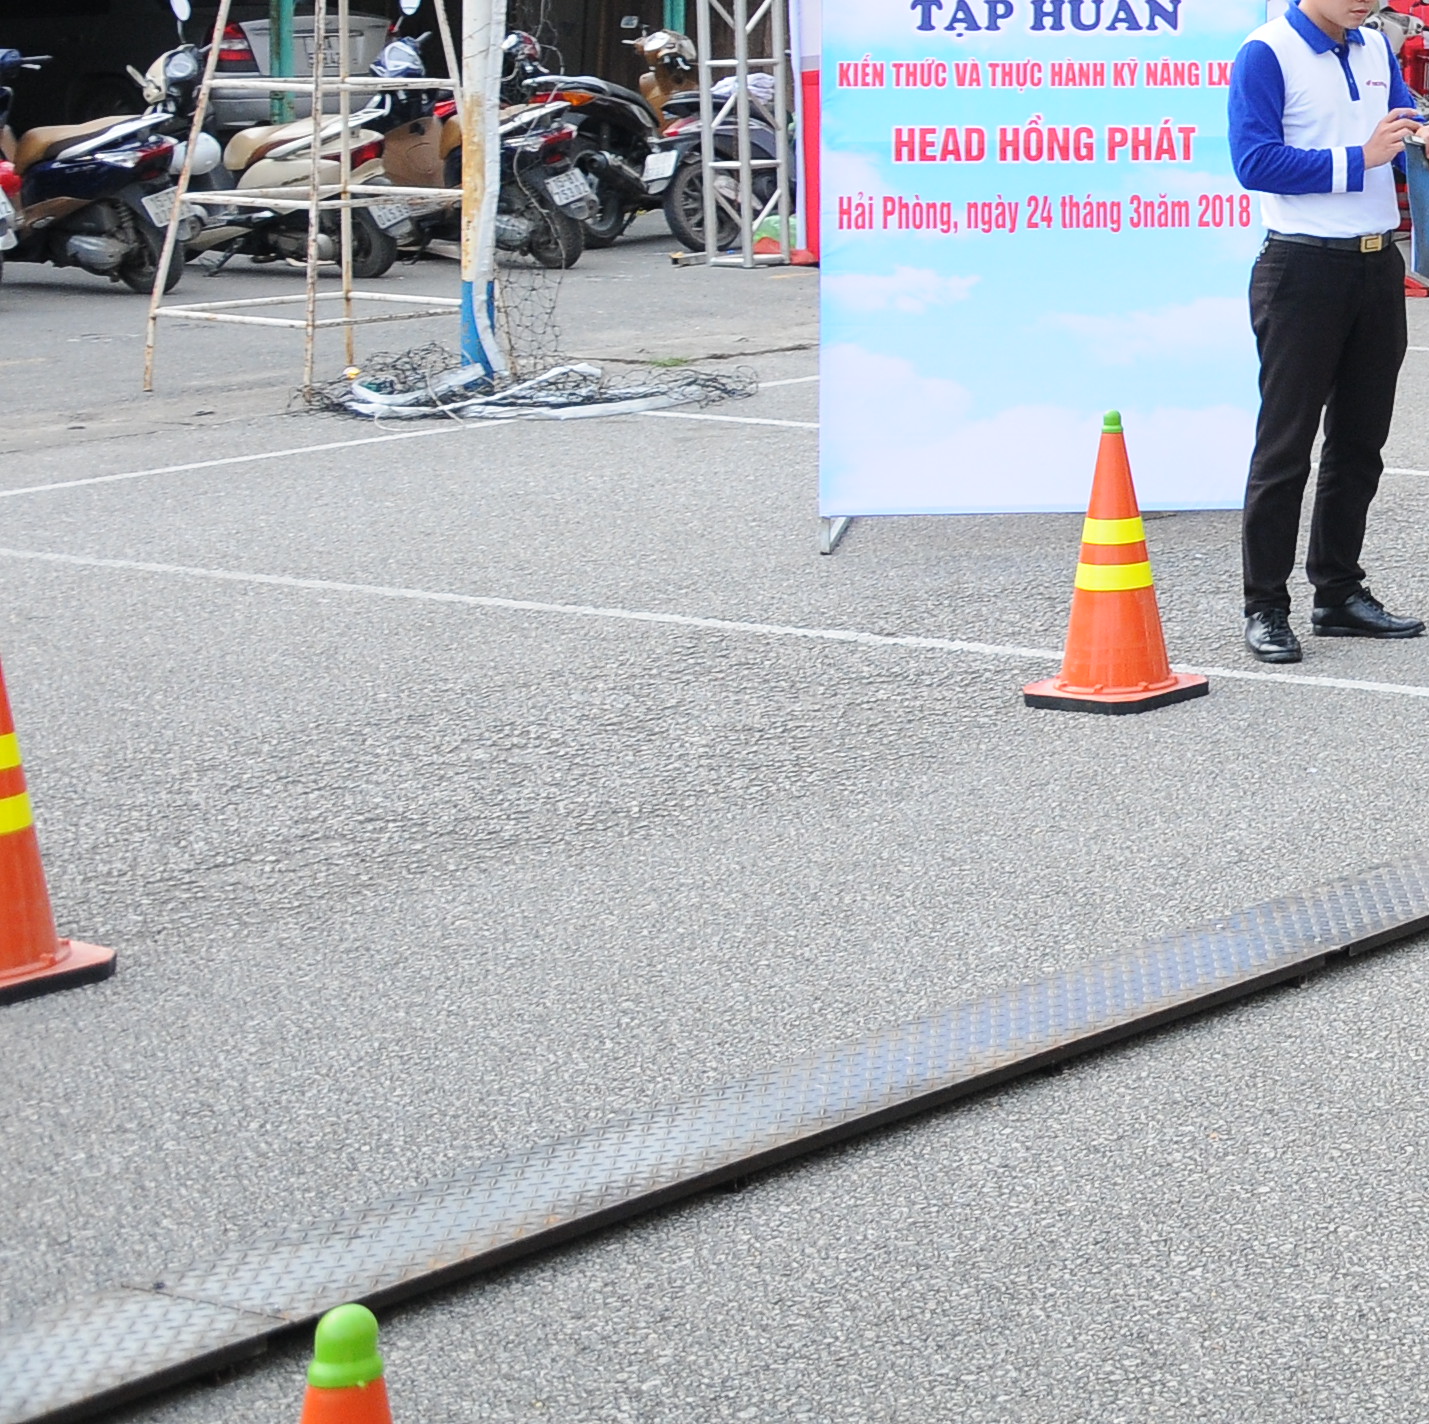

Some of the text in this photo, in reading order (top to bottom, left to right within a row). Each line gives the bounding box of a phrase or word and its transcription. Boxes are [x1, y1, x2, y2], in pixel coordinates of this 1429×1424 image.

[838, 53, 1236, 94] KIẾN THỨC VÀ THỰC HÀNH KỸ NĂNG LX
[893, 115, 1197, 162] HEAD HỒNG PHÁT
[838, 192, 1250, 235] Hải Phòng, ngày 24 tháng 3năm 2018
